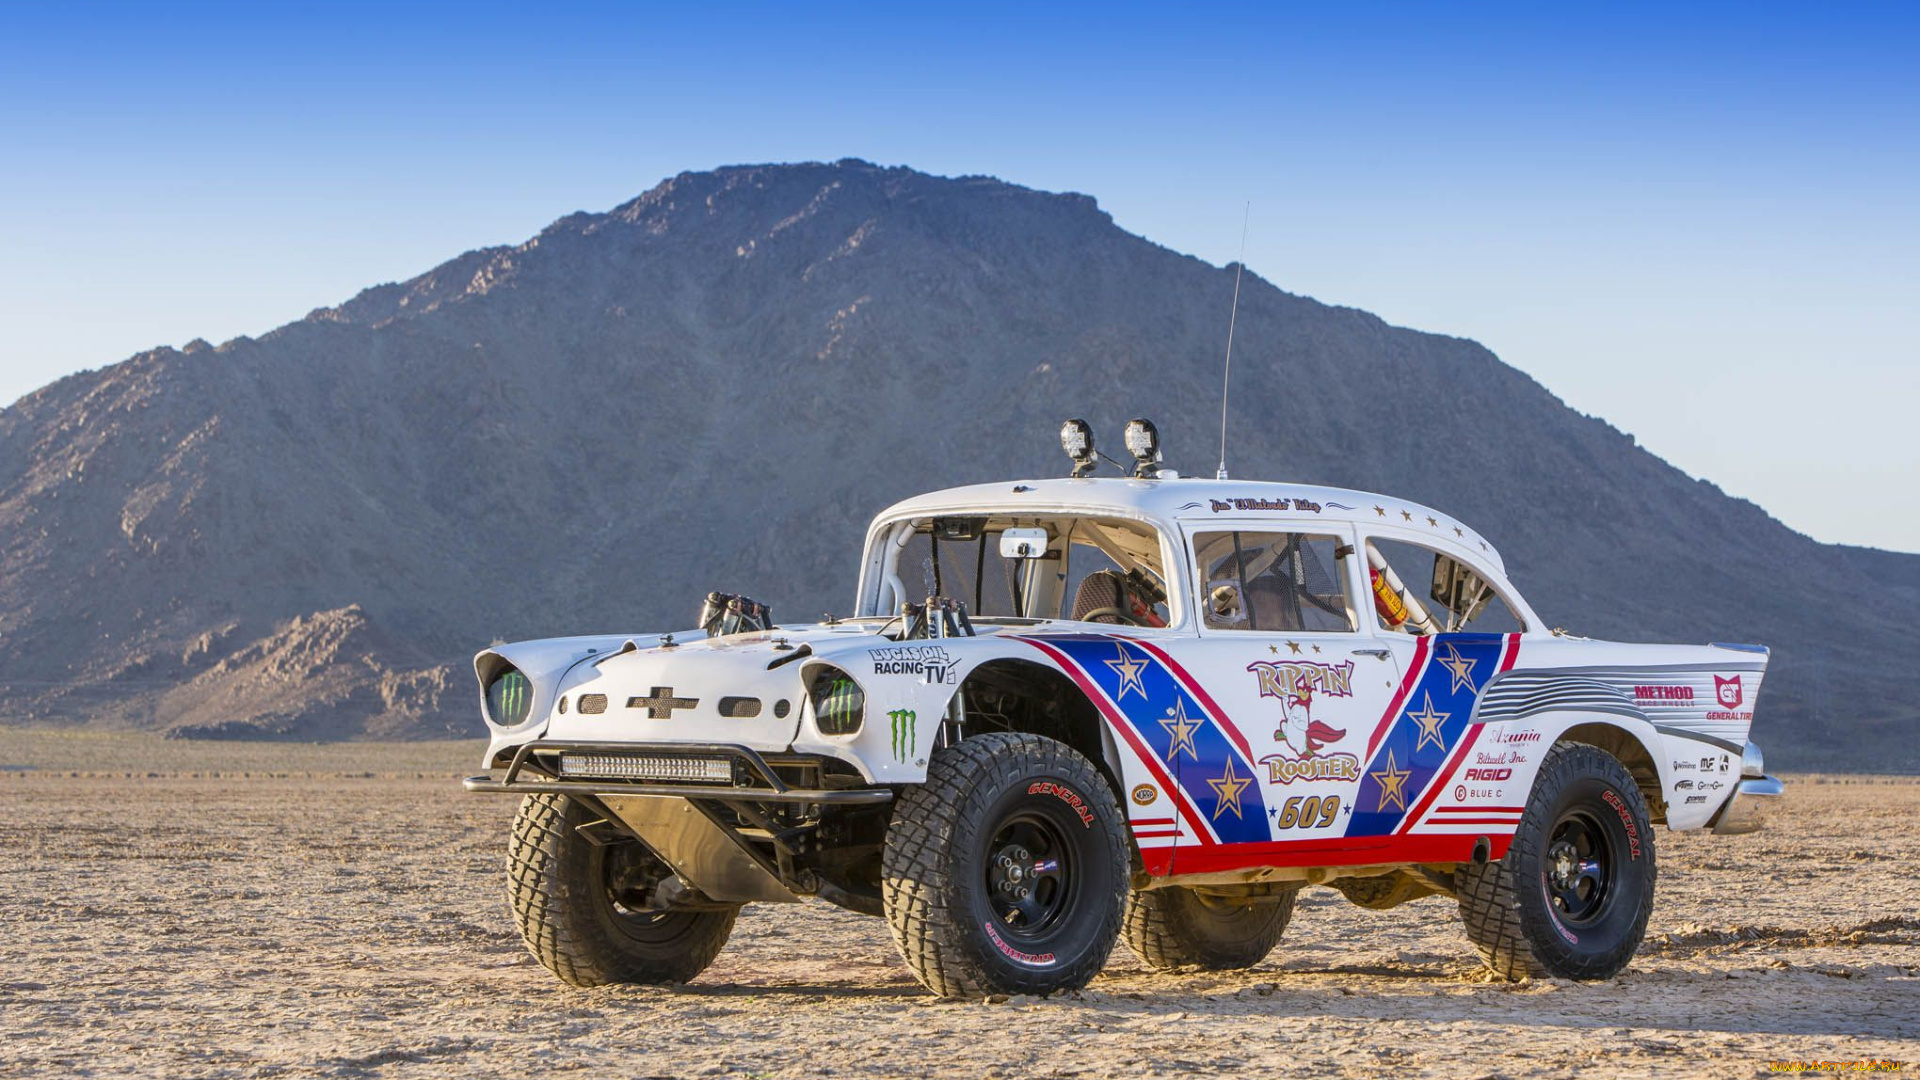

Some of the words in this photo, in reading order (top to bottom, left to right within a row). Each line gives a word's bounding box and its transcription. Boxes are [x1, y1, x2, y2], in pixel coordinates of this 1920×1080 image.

[868, 648, 920, 661] LUCAS
[920, 646, 949, 662] OIL
[874, 662, 924, 674] RACING
[924, 666, 946, 683] TV
[1634, 686, 1694, 699] METHOD
[1706, 711, 1738, 720] GENERAL
[1258, 752, 1361, 785] ROOSTER
[1464, 768, 1512, 780] RIGID
[1470, 789, 1493, 797] BLUE
[1496, 789, 1502, 797] C
[1028, 782, 1095, 829] GENERAL
[1278, 795, 1340, 829] 609
[1602, 790, 1641, 861] GENERAL
